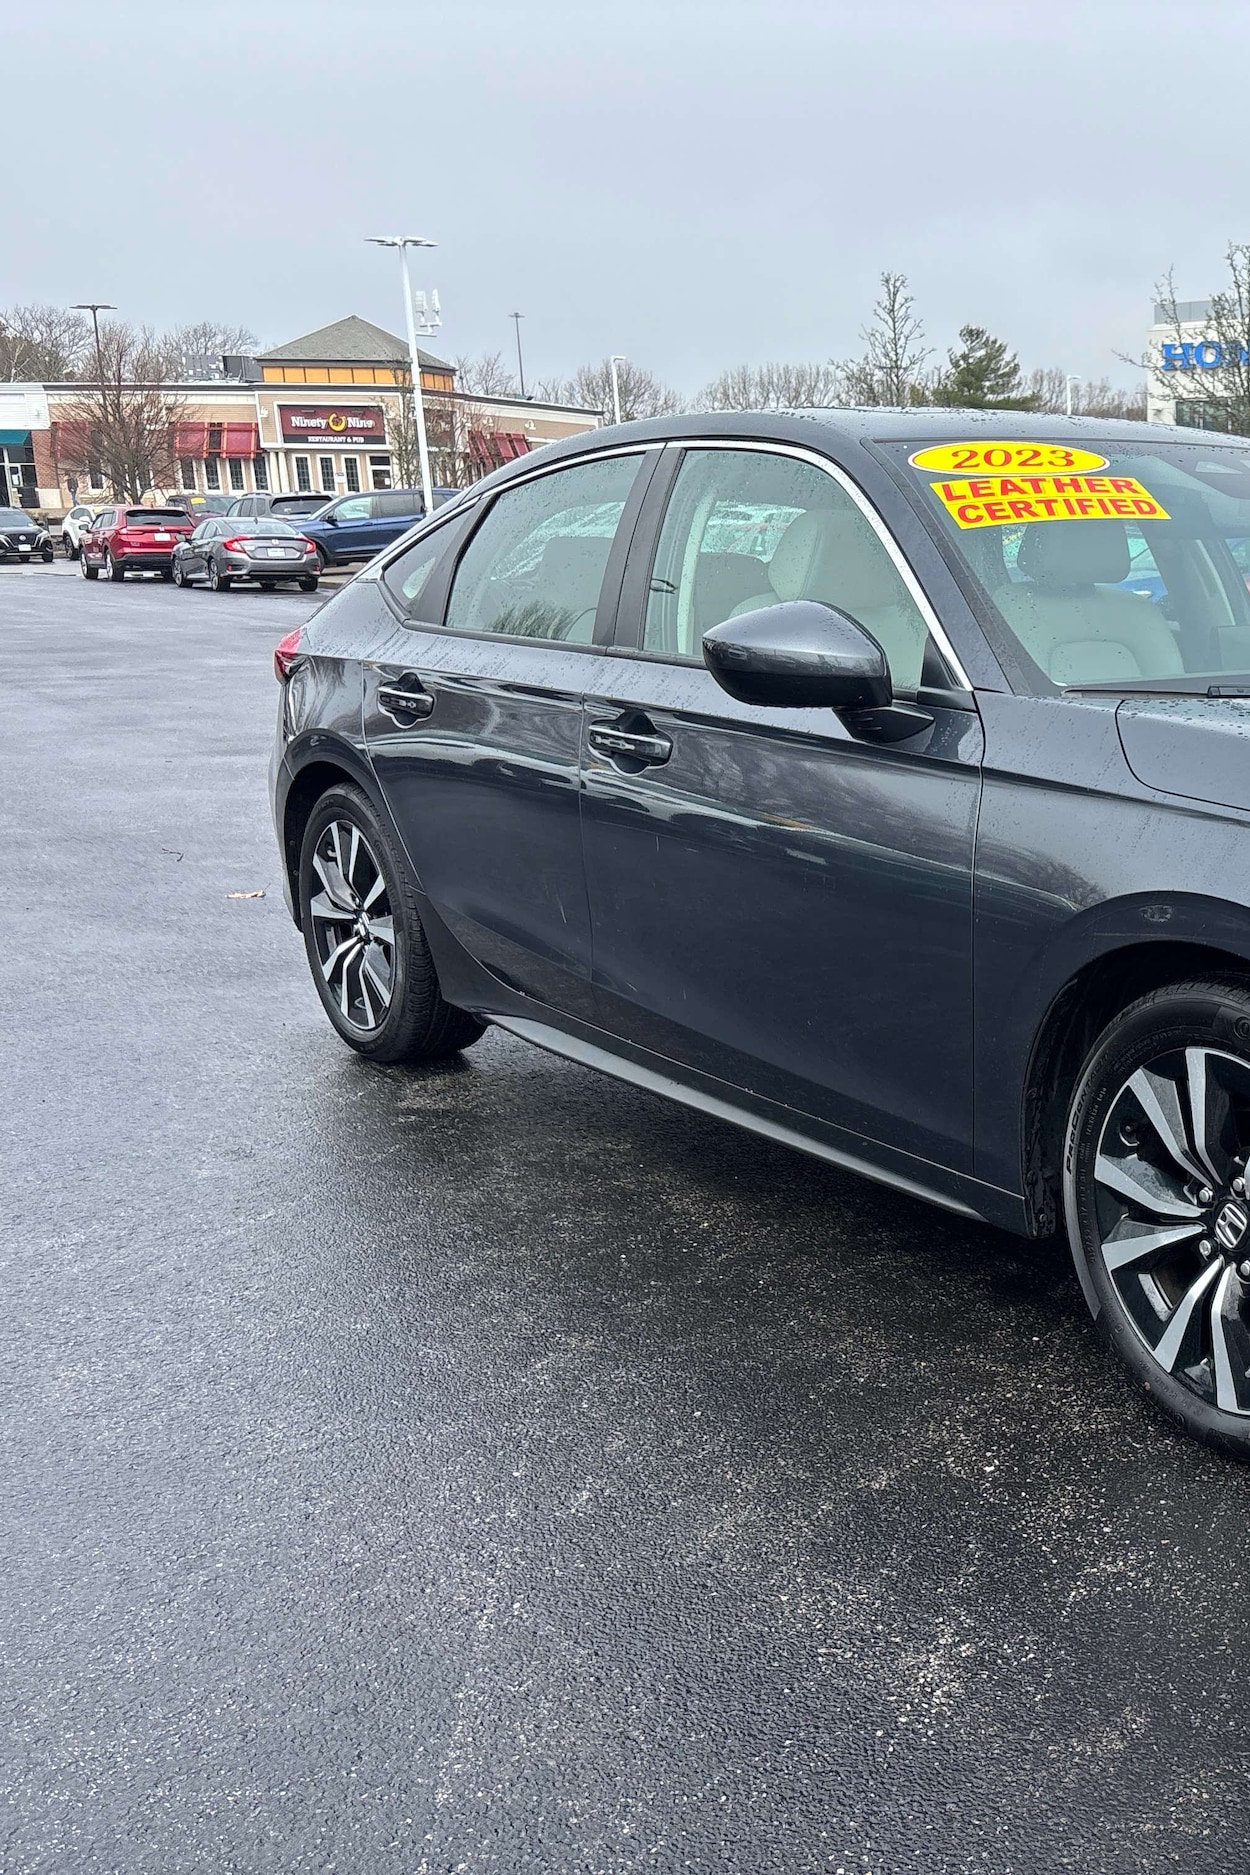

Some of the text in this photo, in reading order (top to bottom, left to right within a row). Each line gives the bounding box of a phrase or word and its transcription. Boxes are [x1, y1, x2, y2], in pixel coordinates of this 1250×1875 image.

[290, 416, 373, 429] Ninety Nine
[951, 449, 1075, 469] 2023
[941, 477, 1145, 502] LEATHER
[957, 498, 1157, 524] CERTIFIED
